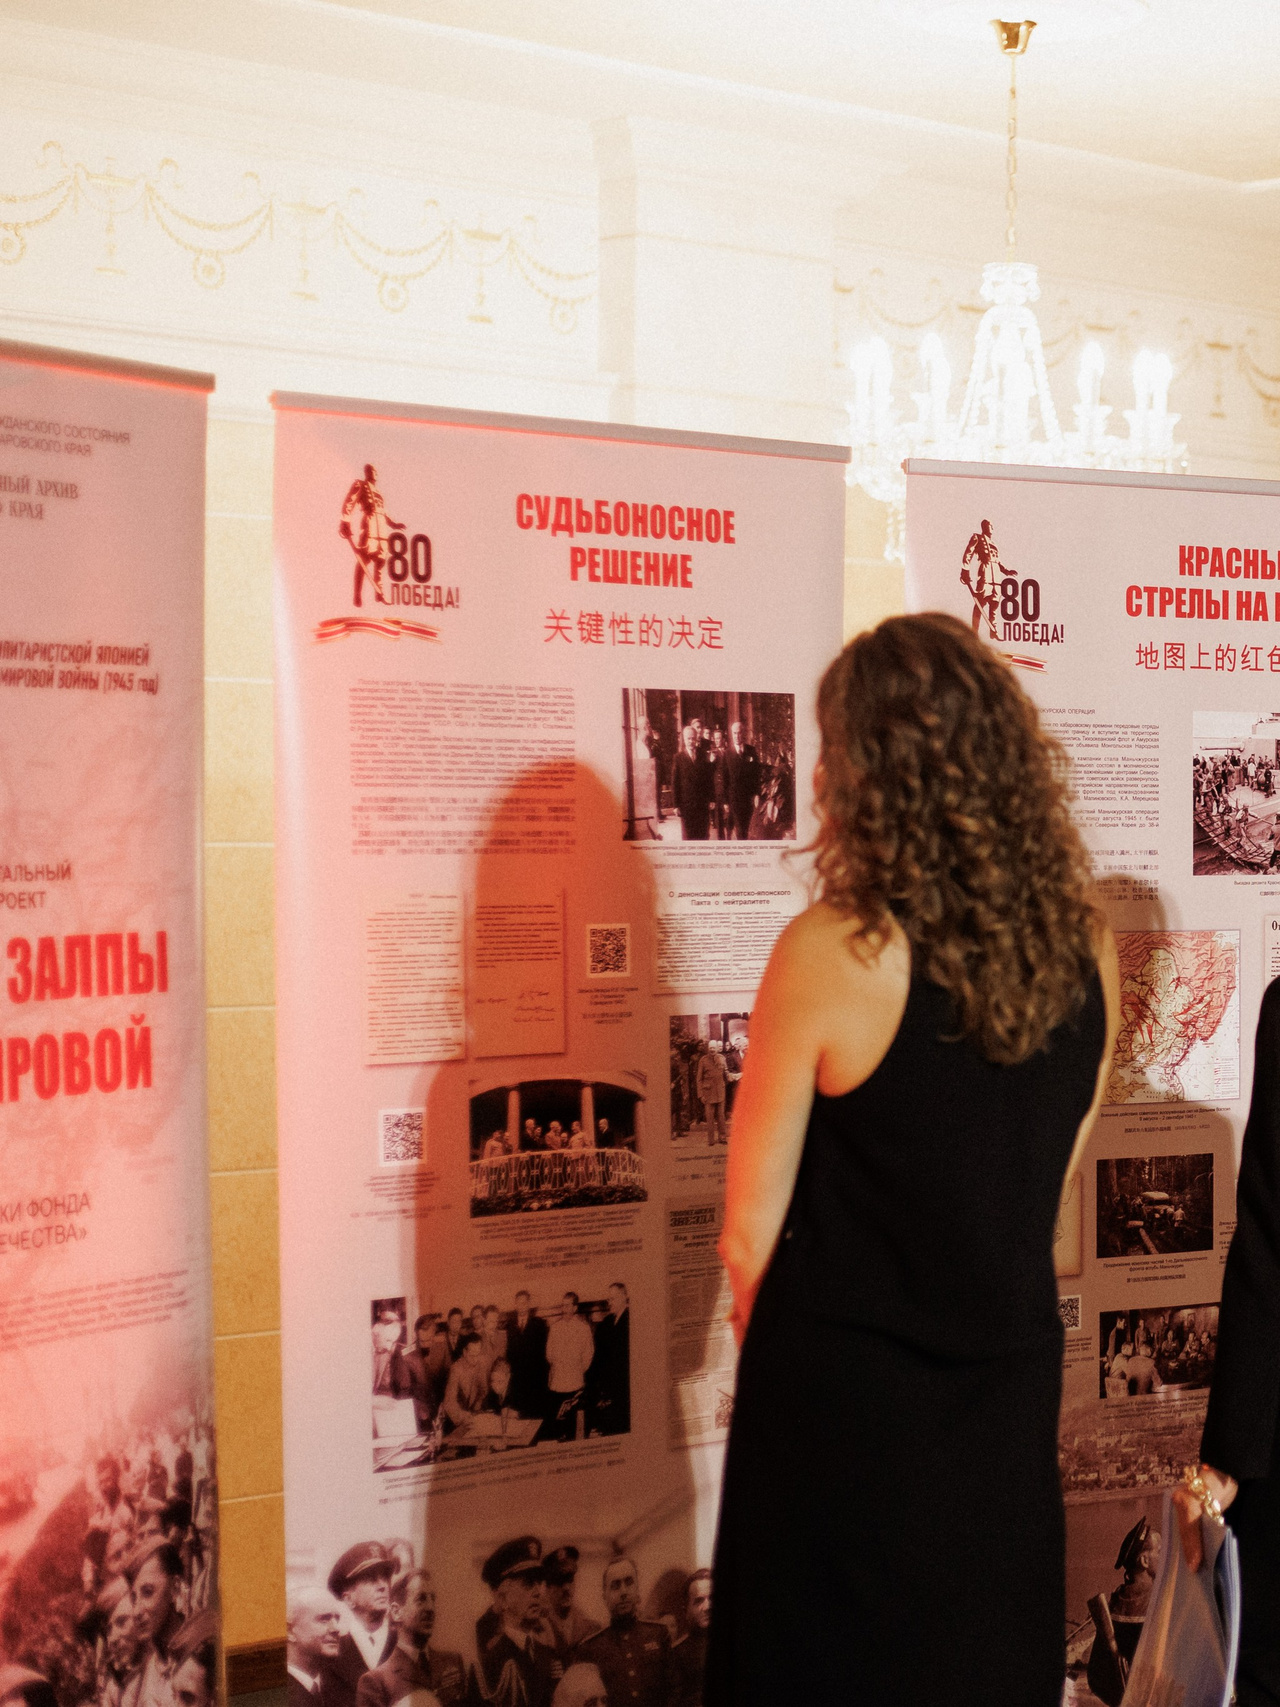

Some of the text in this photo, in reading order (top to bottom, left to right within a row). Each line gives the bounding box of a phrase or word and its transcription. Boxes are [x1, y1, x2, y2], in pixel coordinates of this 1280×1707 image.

[64, 424, 130, 444] СОСТОЯНИЯ
[64, 442, 91, 457] КРАЯ
[36, 480, 79, 499] АРХИВ
[9, 501, 43, 520] КРАЯ
[515, 493, 736, 544] СУДЬБОНОСНОЕ
[387, 532, 432, 583] 80
[570, 546, 693, 589] РЕШЕНИЕ
[389, 583, 460, 611] ПОБЕДА!
[1000, 578, 1041, 622] 80
[1125, 585, 1229, 621] СТРЕЛЫ
[1237, 591, 1269, 623] НА
[544, 608, 725, 650] 关键性的决定
[1002, 622, 1065, 646] ПОБЕДА!
[96, 643, 150, 666] ЯПОНИЕЙ
[59, 666, 100, 690] ВОЙНЫ
[104, 671, 134, 694] (1945
[137, 673, 159, 695] год)
[678, 891, 720, 899] денонсации
[723, 898, 770, 906] нейтралитете
[7, 931, 168, 1004] ЗАЛПЫ
[0, 1013, 152, 1104] РОВОЙ
[26, 1192, 92, 1218] ФОНДА
